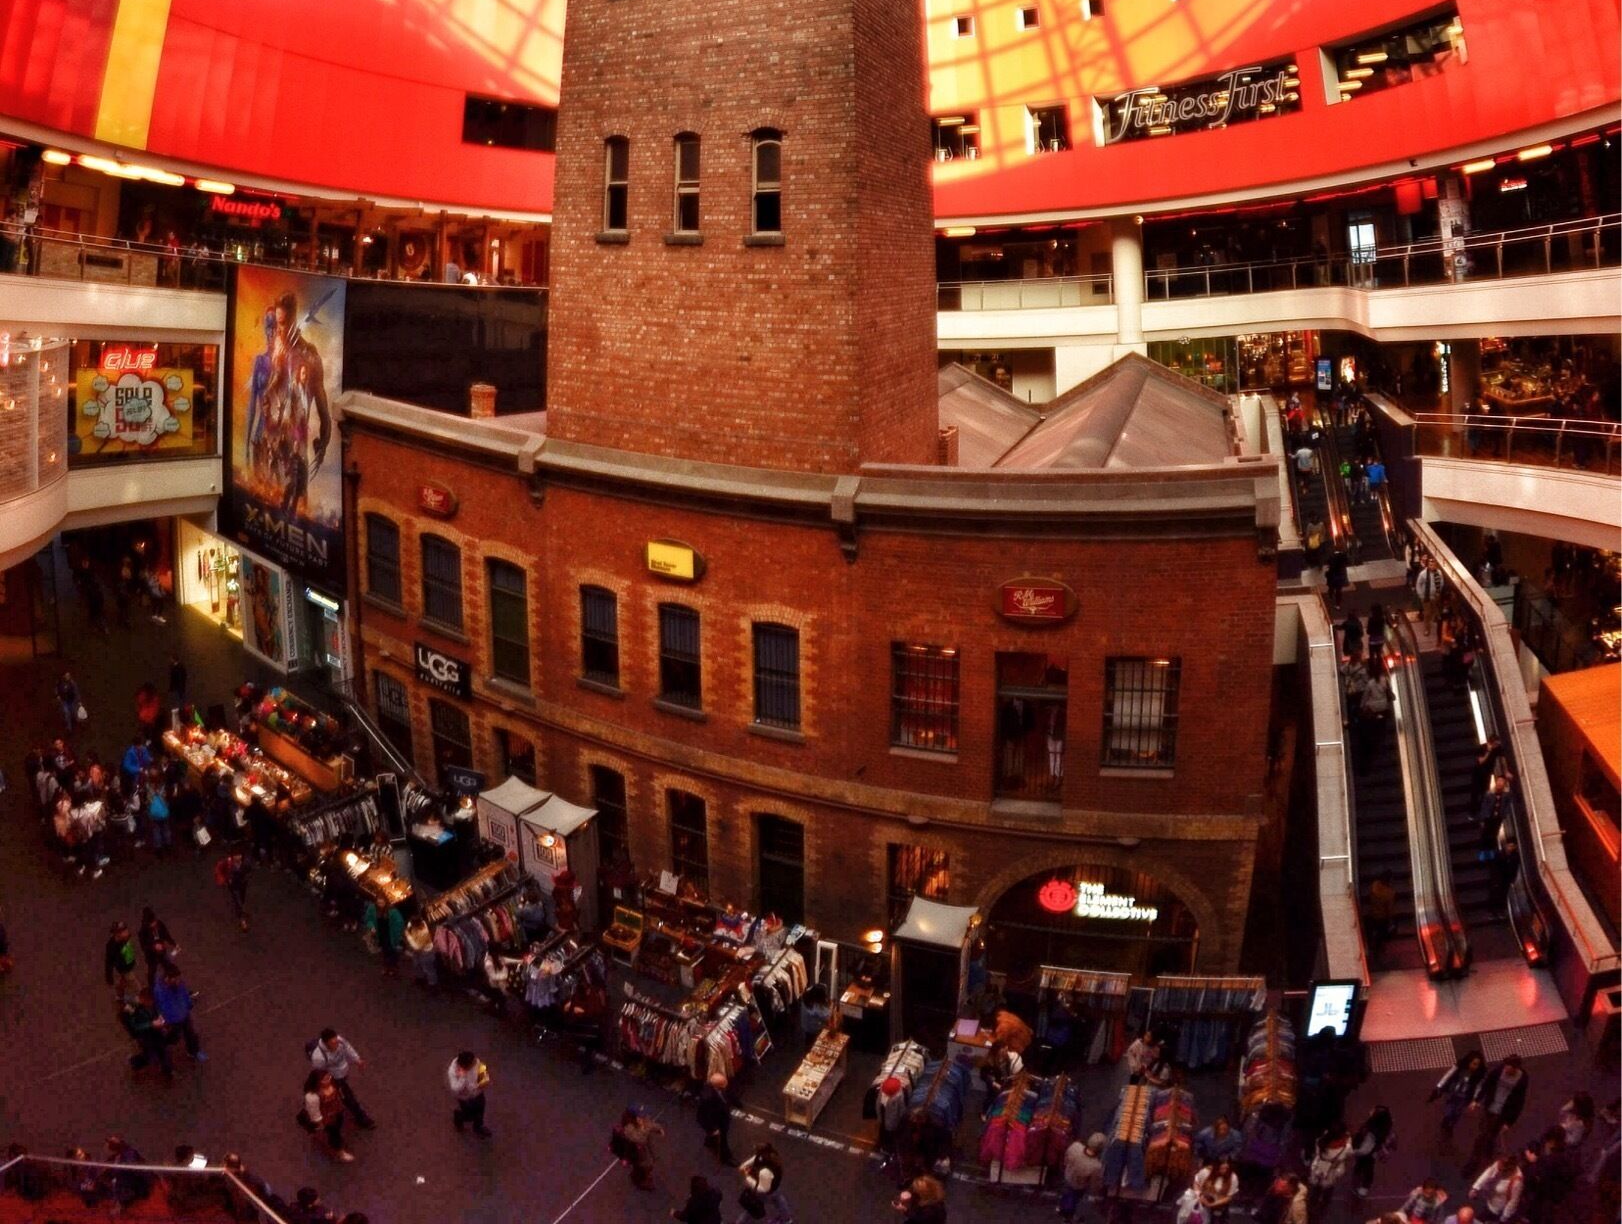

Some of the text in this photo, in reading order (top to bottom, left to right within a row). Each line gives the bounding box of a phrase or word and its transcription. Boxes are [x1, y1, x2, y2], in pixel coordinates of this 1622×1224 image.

[1106, 67, 1290, 144] Fitness First
[212, 196, 281, 219] Nando's
[245, 503, 328, 560] X-MEN
[418, 647, 460, 682] UGG
[1079, 881, 1105, 895] THE
[1076, 904, 1158, 921] COLLECTIVE
[1078, 893, 1136, 909] ELEMENT
